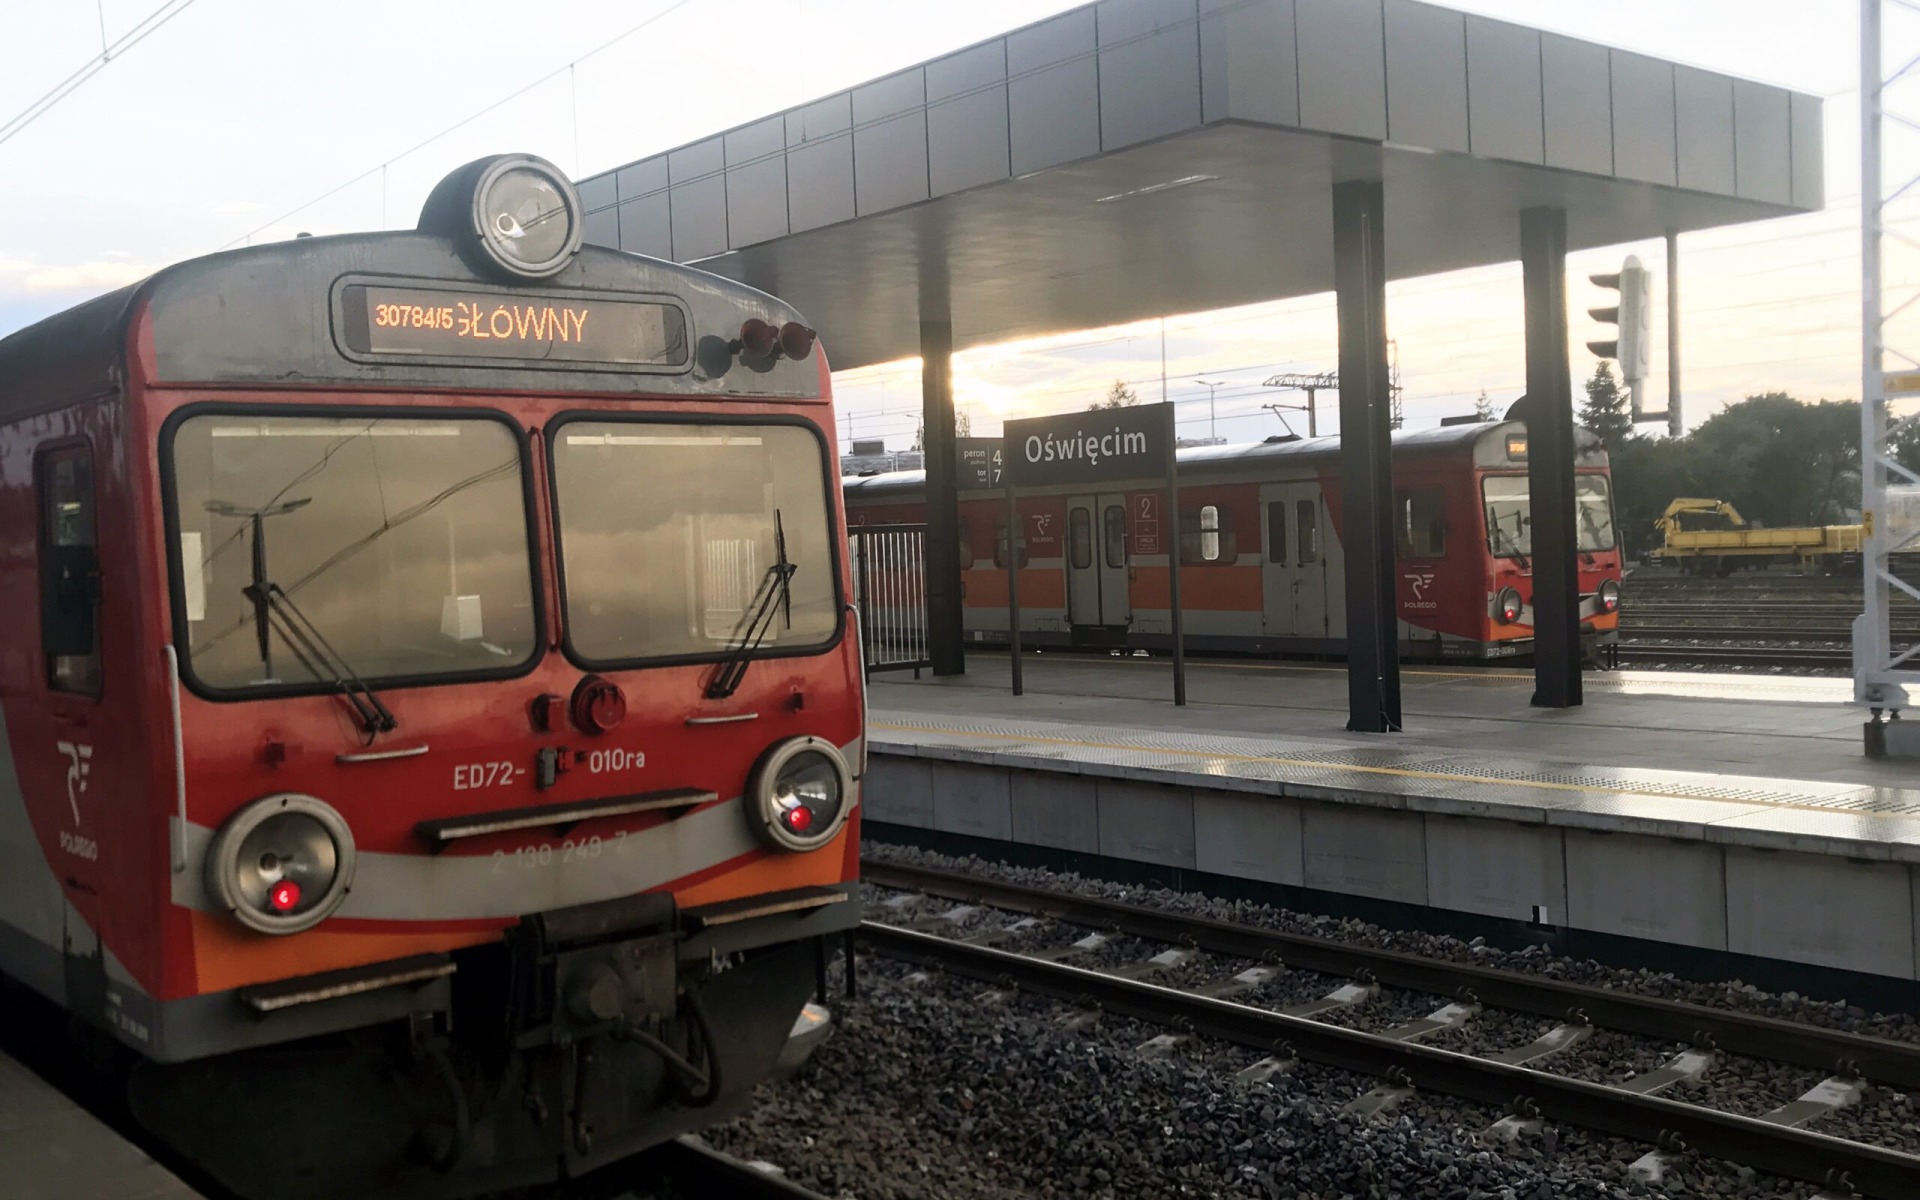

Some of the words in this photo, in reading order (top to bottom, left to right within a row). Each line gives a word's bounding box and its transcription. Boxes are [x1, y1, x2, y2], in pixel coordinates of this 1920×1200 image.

[375, 304, 454, 330] 30784/5
[964, 450, 985, 460] peron
[1025, 427, 1146, 465] Oświęcim
[993, 449, 1002, 465] 4
[977, 469, 987, 477] tor
[994, 469, 1002, 483] 7
[1141, 497, 1151, 518] 2
[453, 761, 526, 790] ED72-
[590, 748, 646, 774] 010ra
[492, 848, 505, 875] 2
[516, 843, 552, 869] 130
